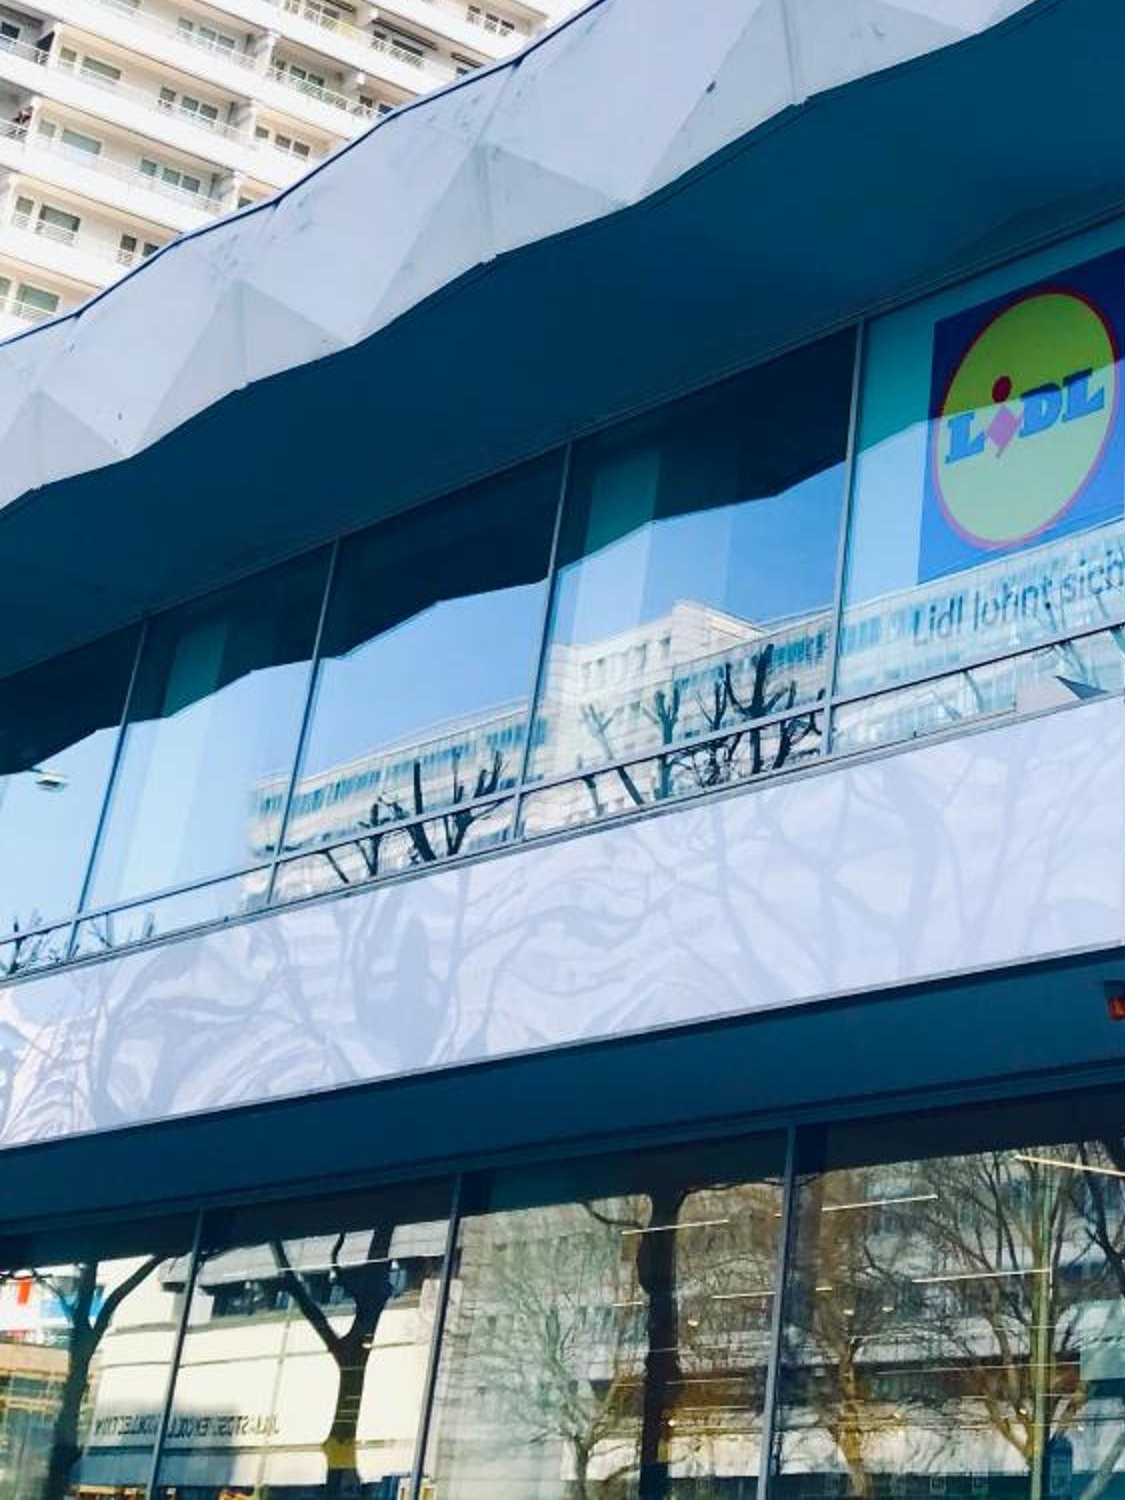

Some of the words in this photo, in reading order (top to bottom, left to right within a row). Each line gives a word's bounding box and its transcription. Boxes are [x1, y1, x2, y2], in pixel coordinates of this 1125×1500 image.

[913, 595, 963, 647] Lidl
[974, 576, 1053, 631] lohnt
[1061, 550, 1125, 600] sich
